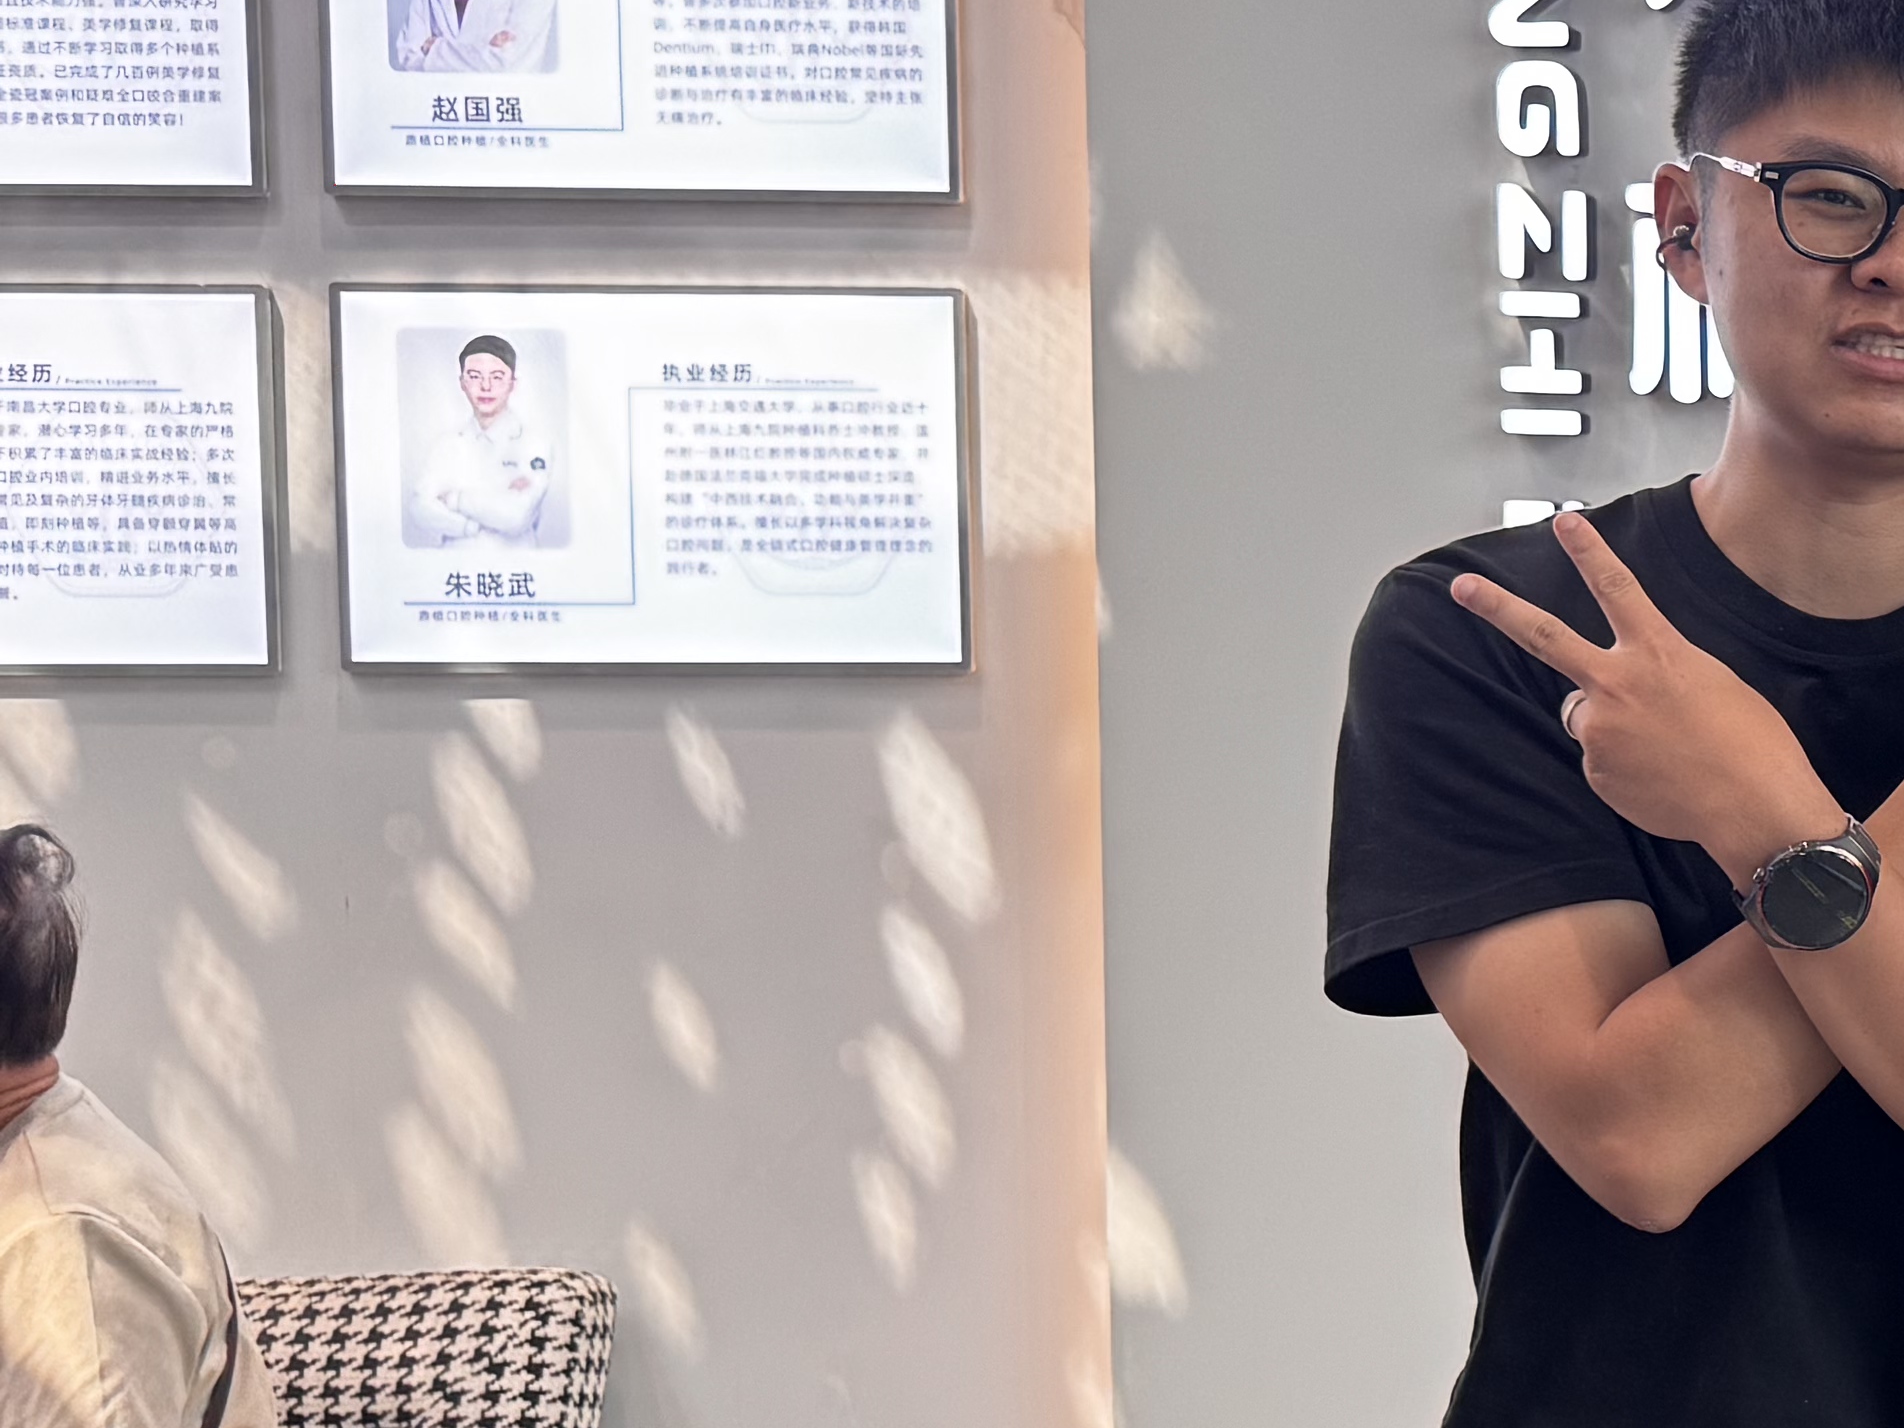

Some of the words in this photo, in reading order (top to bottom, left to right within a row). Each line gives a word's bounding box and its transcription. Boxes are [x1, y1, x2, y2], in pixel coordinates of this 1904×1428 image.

[431, 95, 524, 123] 赵国强
[0, 363, 52, 383] 经历
[662, 363, 752, 384] 执业经历
[445, 571, 536, 598] 朱晓武
